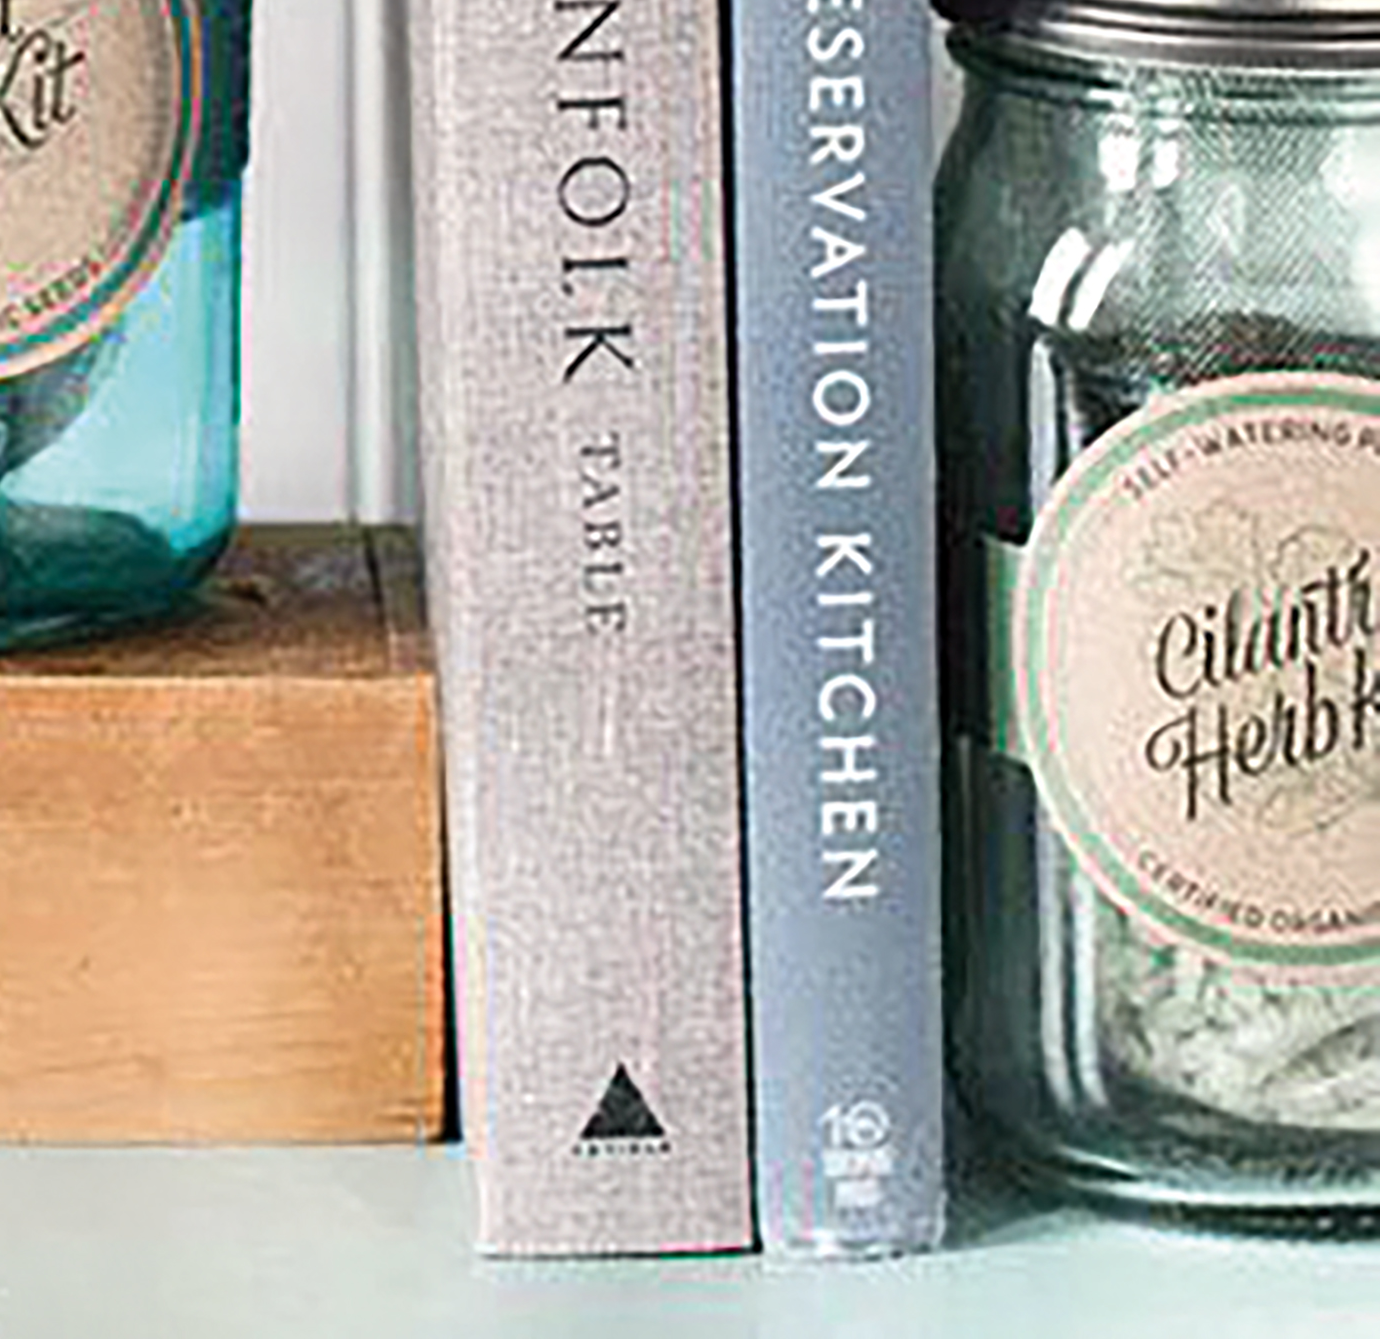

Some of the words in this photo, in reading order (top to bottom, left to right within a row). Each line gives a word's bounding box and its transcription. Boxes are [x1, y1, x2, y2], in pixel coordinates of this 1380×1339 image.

[580, 431, 627, 635] TABLE
[1123, 420, 1353, 500] SELF-WATERING
[816, 531, 881, 900] KITCHEN
[1144, 658, 1340, 821] Herb
